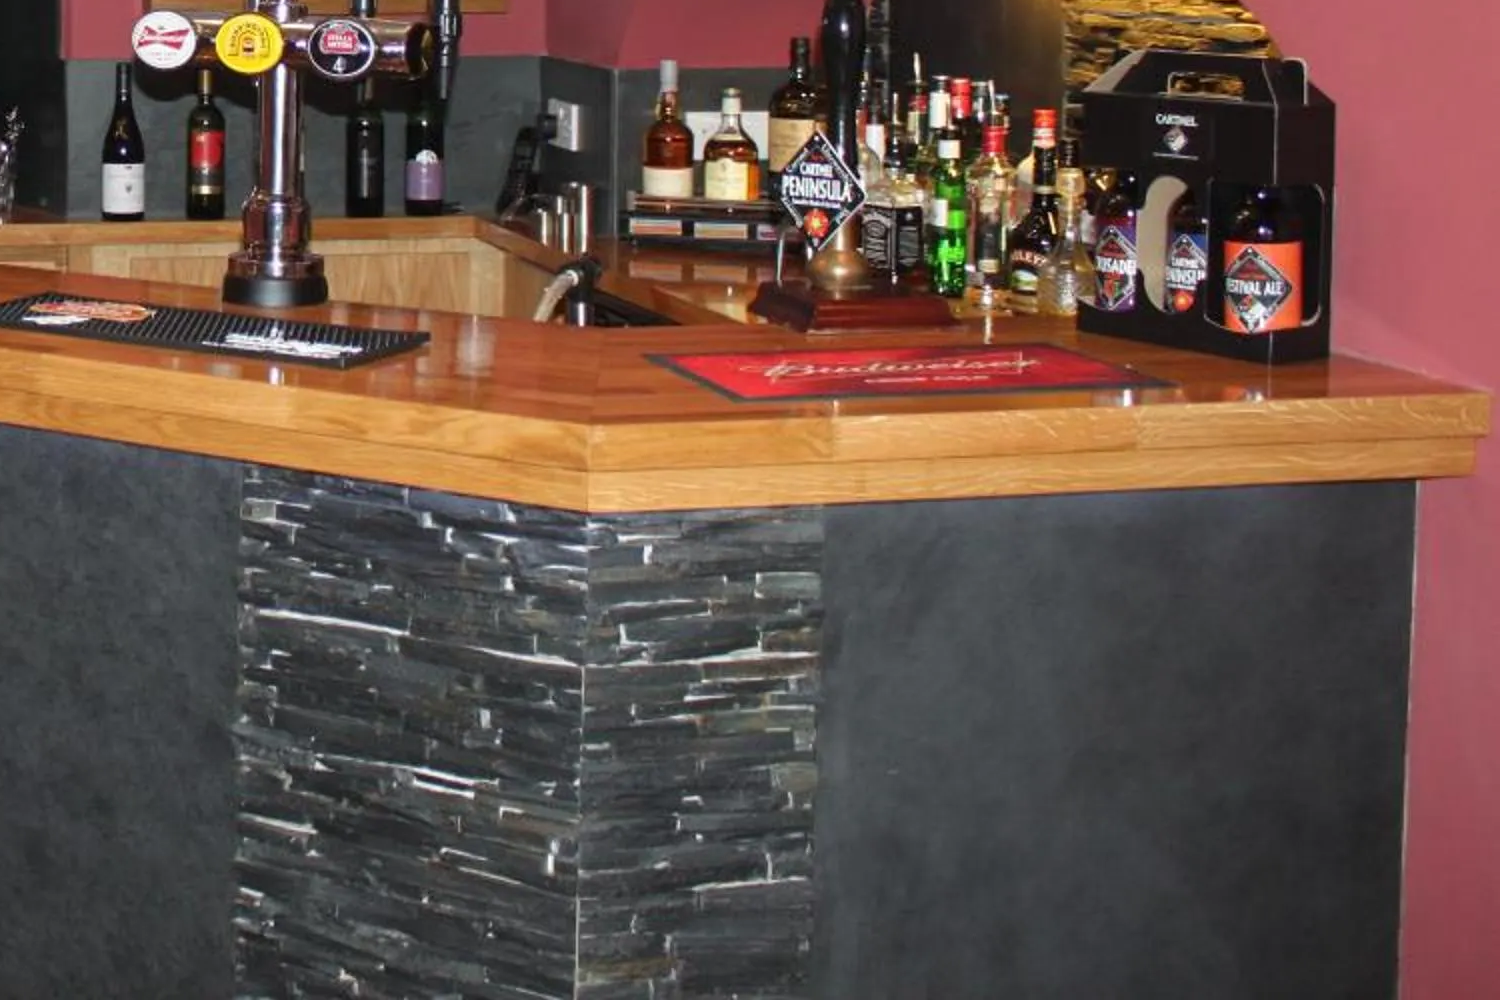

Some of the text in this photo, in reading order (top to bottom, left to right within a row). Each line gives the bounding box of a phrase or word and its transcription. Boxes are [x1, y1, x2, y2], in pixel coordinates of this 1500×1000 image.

[333, 56, 346, 72] 4
[781, 175, 853, 202] PENINSULA
[1263, 279, 1285, 297] ALE
